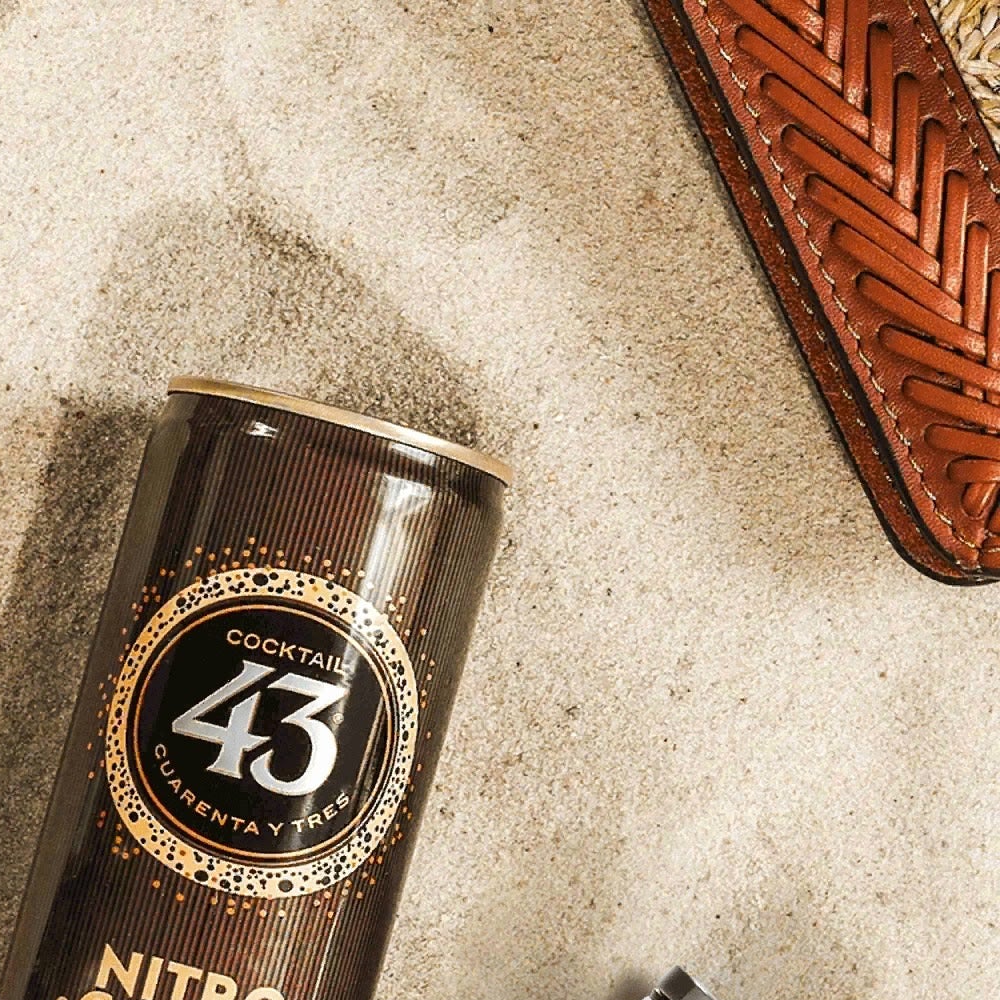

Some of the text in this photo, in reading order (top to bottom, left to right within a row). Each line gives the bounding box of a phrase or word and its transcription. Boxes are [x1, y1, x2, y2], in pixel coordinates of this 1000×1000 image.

[226, 629, 348, 676] COCKTAIL
[171, 659, 349, 797] 43
[154, 743, 350, 837] CUARENTA Y TRES
